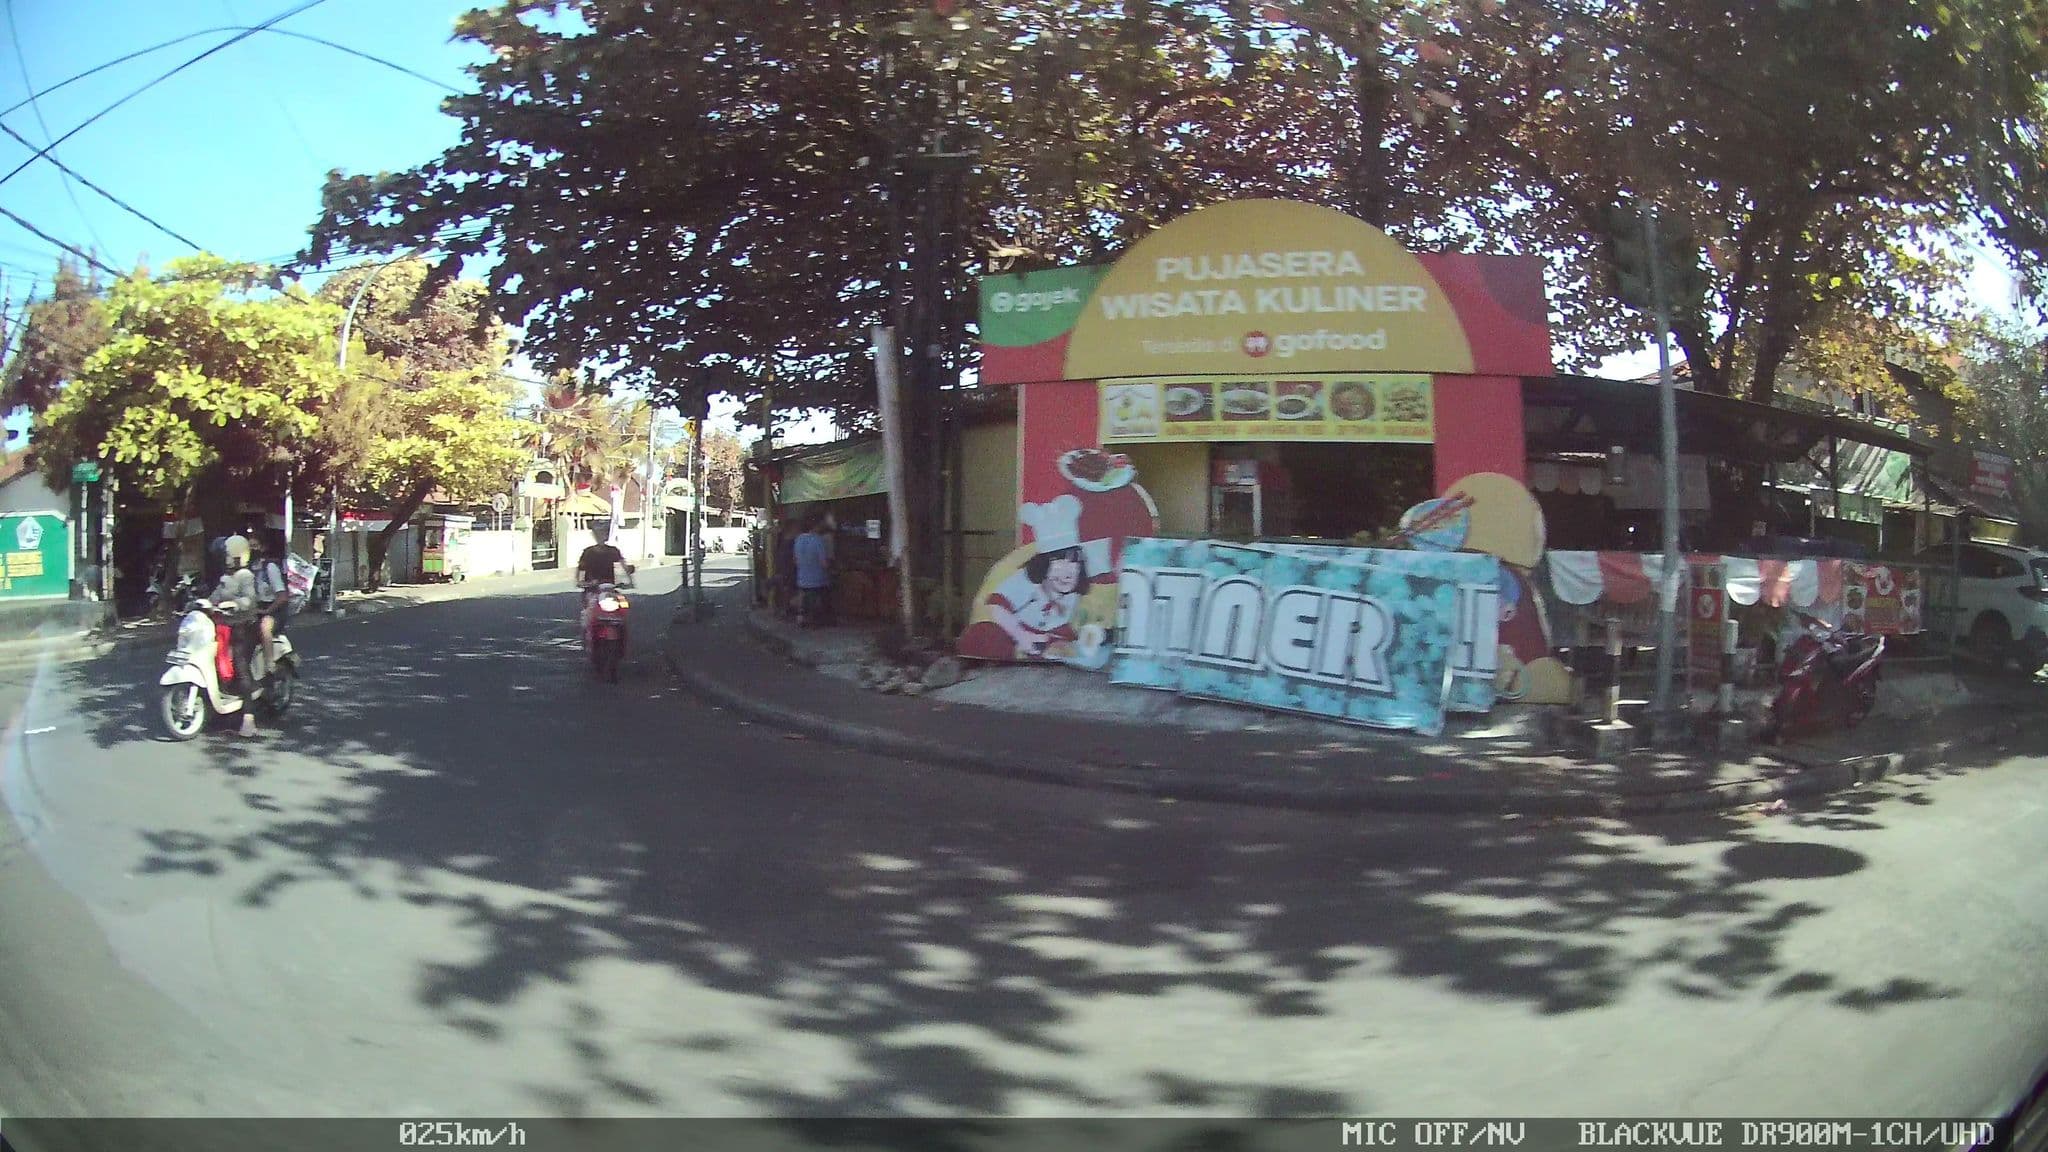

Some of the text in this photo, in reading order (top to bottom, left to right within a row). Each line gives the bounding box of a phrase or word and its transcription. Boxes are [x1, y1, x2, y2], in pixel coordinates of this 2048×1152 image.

[1156, 250, 1365, 282] PUJASERA
[1100, 285, 1428, 321] WISATA KULINER
[1273, 328, 1387, 358] gofood
